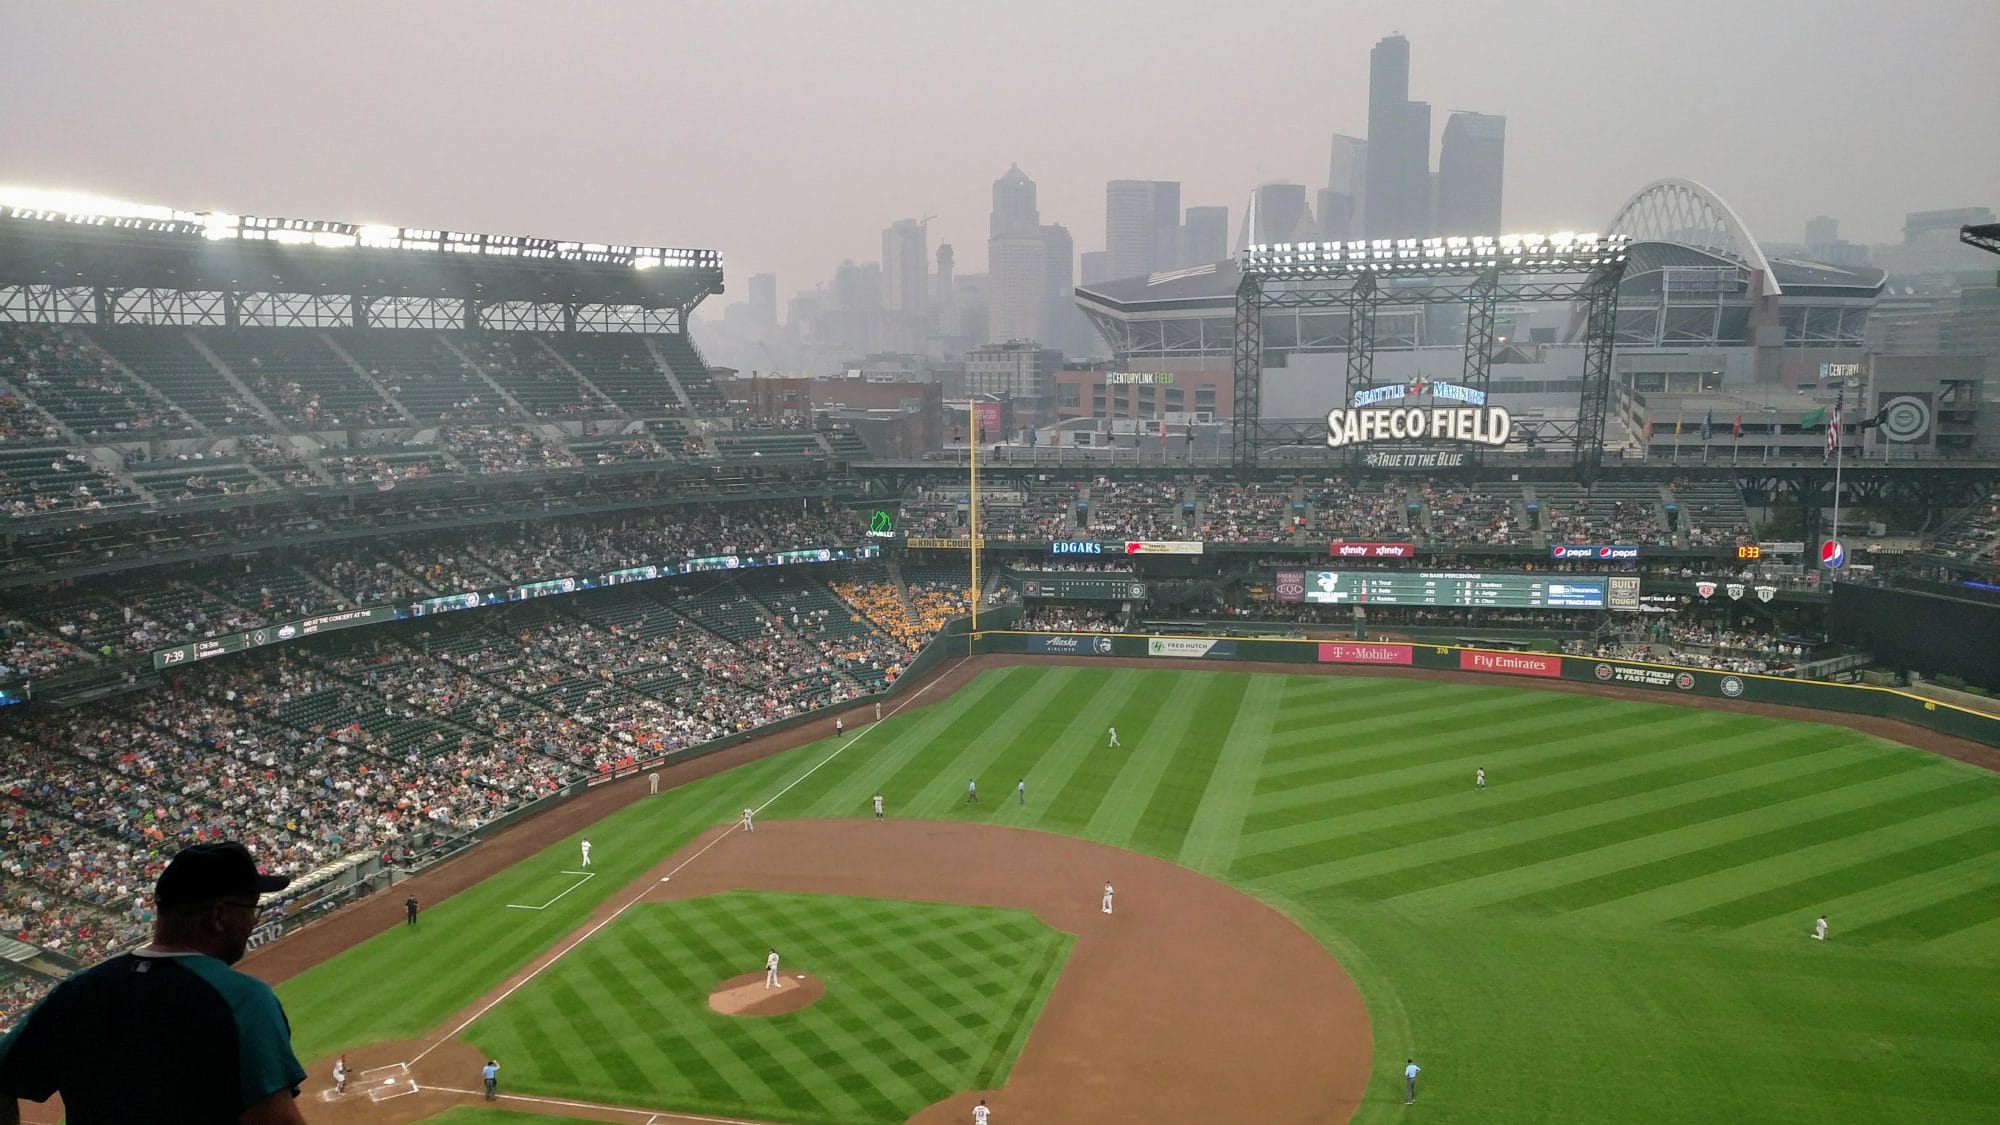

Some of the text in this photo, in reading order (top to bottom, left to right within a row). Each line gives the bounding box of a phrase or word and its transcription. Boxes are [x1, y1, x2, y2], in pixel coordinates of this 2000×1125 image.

[1112, 371, 1174, 385] CENTURYLINK FIELD
[1354, 381, 1486, 407] SEATTLE MARINERS
[1326, 405, 1511, 448] SAFECO FIELD
[1377, 451, 1464, 467] TRUE TO THE BLUE
[918, 539, 945, 547] KING'S
[1339, 545, 1368, 556] xfinity
[1375, 545, 1404, 556] xfinity
[1567, 549, 1592, 558] pepsi
[1612, 549, 1637, 558] pepsi
[1738, 546, 1760, 558] 0:33
[1611, 580, 1637, 589] BUILT
[1045, 636, 1078, 647] Alaska
[163, 650, 184, 664] 7:39
[1474, 655, 1546, 670] Fly Emirates
[1614, 667, 1646, 676] WHERE
[1645, 670, 1675, 679] FRESH
[1646, 677, 1673, 685] MEET
